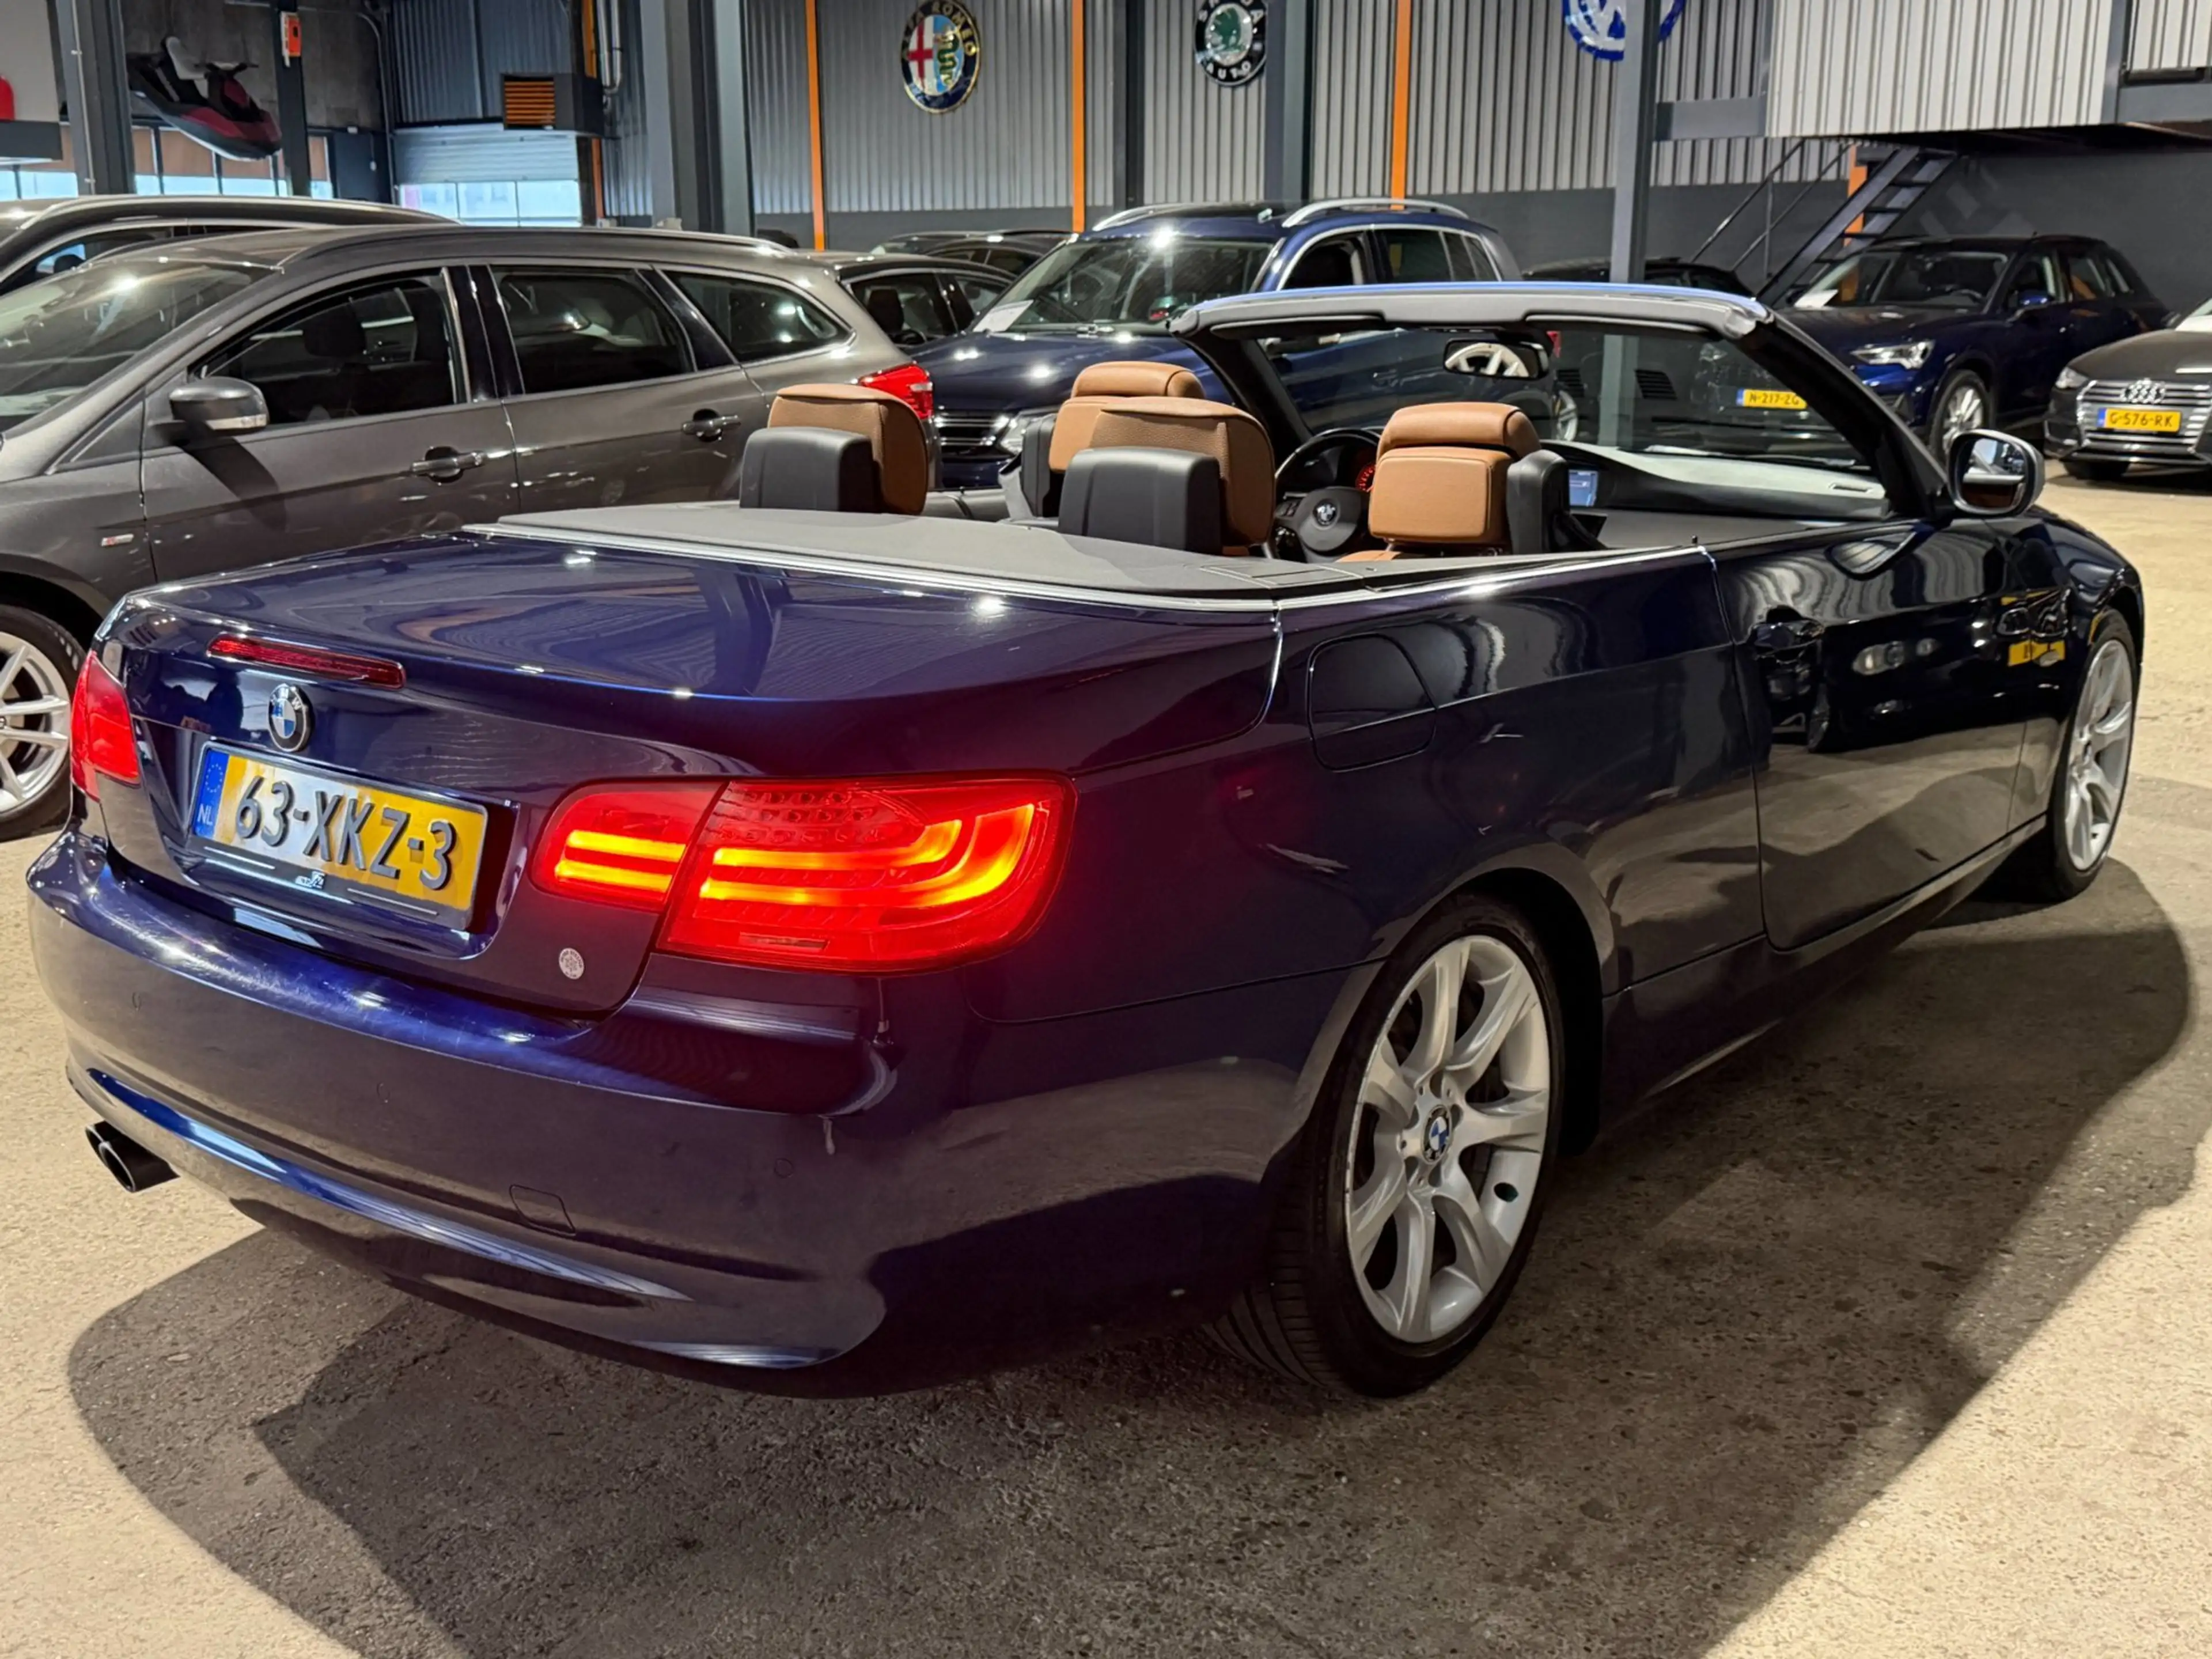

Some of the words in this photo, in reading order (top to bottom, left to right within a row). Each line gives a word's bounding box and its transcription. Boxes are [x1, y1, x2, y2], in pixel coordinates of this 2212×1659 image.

[2109, 411, 2173, 427] G-576-RK
[197, 803, 213, 825] NL
[236, 775, 457, 891] 63-XKZ-3
